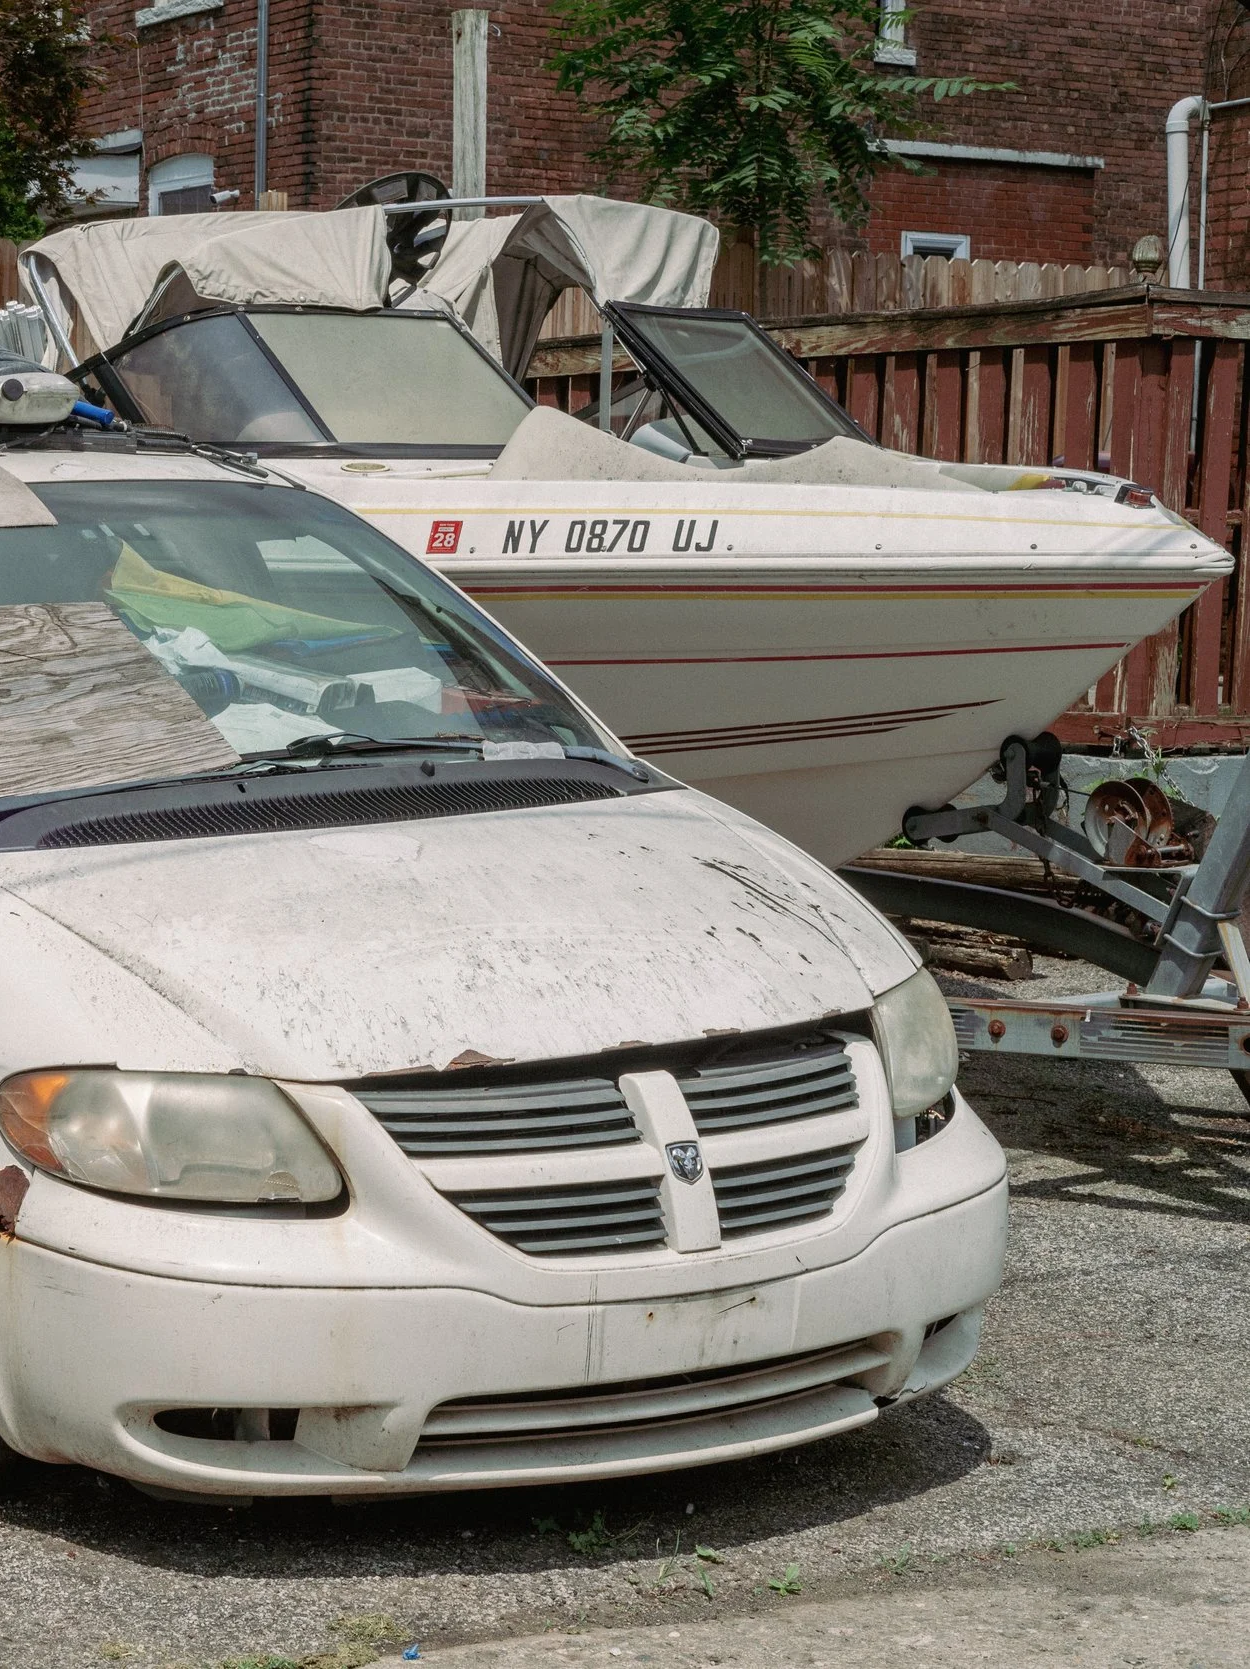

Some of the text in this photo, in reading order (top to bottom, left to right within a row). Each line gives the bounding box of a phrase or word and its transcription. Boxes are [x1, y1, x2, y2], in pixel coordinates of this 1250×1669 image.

[432, 533, 455, 547] 28
[502, 519, 720, 554] NY 0870 UJ
